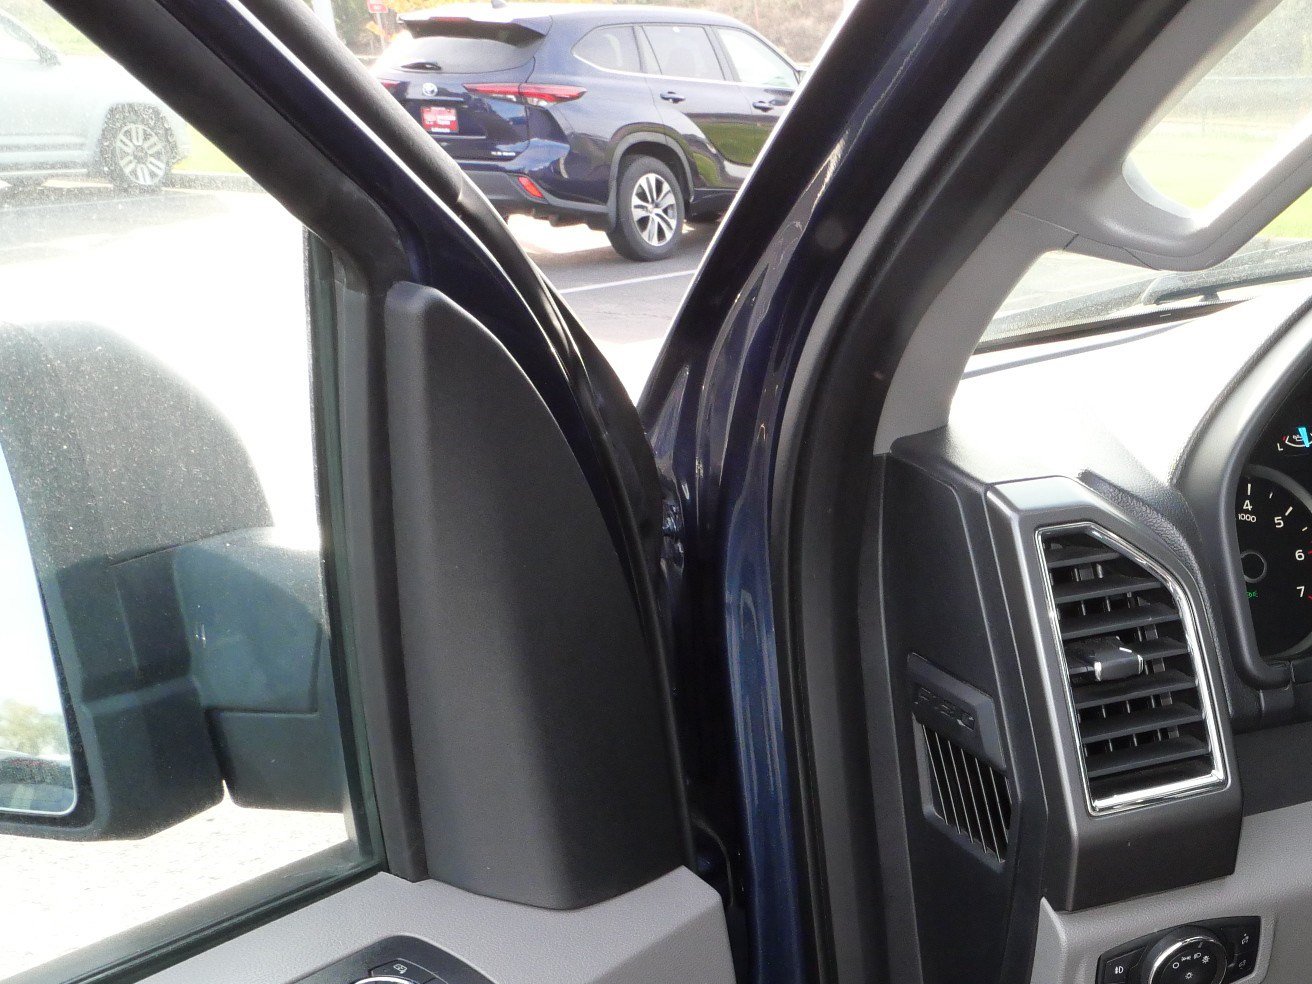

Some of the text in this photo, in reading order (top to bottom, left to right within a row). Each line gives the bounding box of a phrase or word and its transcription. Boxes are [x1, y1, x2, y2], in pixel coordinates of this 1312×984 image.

[1243, 500, 1252, 511] 4
[1238, 513, 1257, 523] 1000
[1274, 516, 1284, 528] 5
[1295, 549, 1305, 561] 6
[1296, 586, 1305, 598] 7
